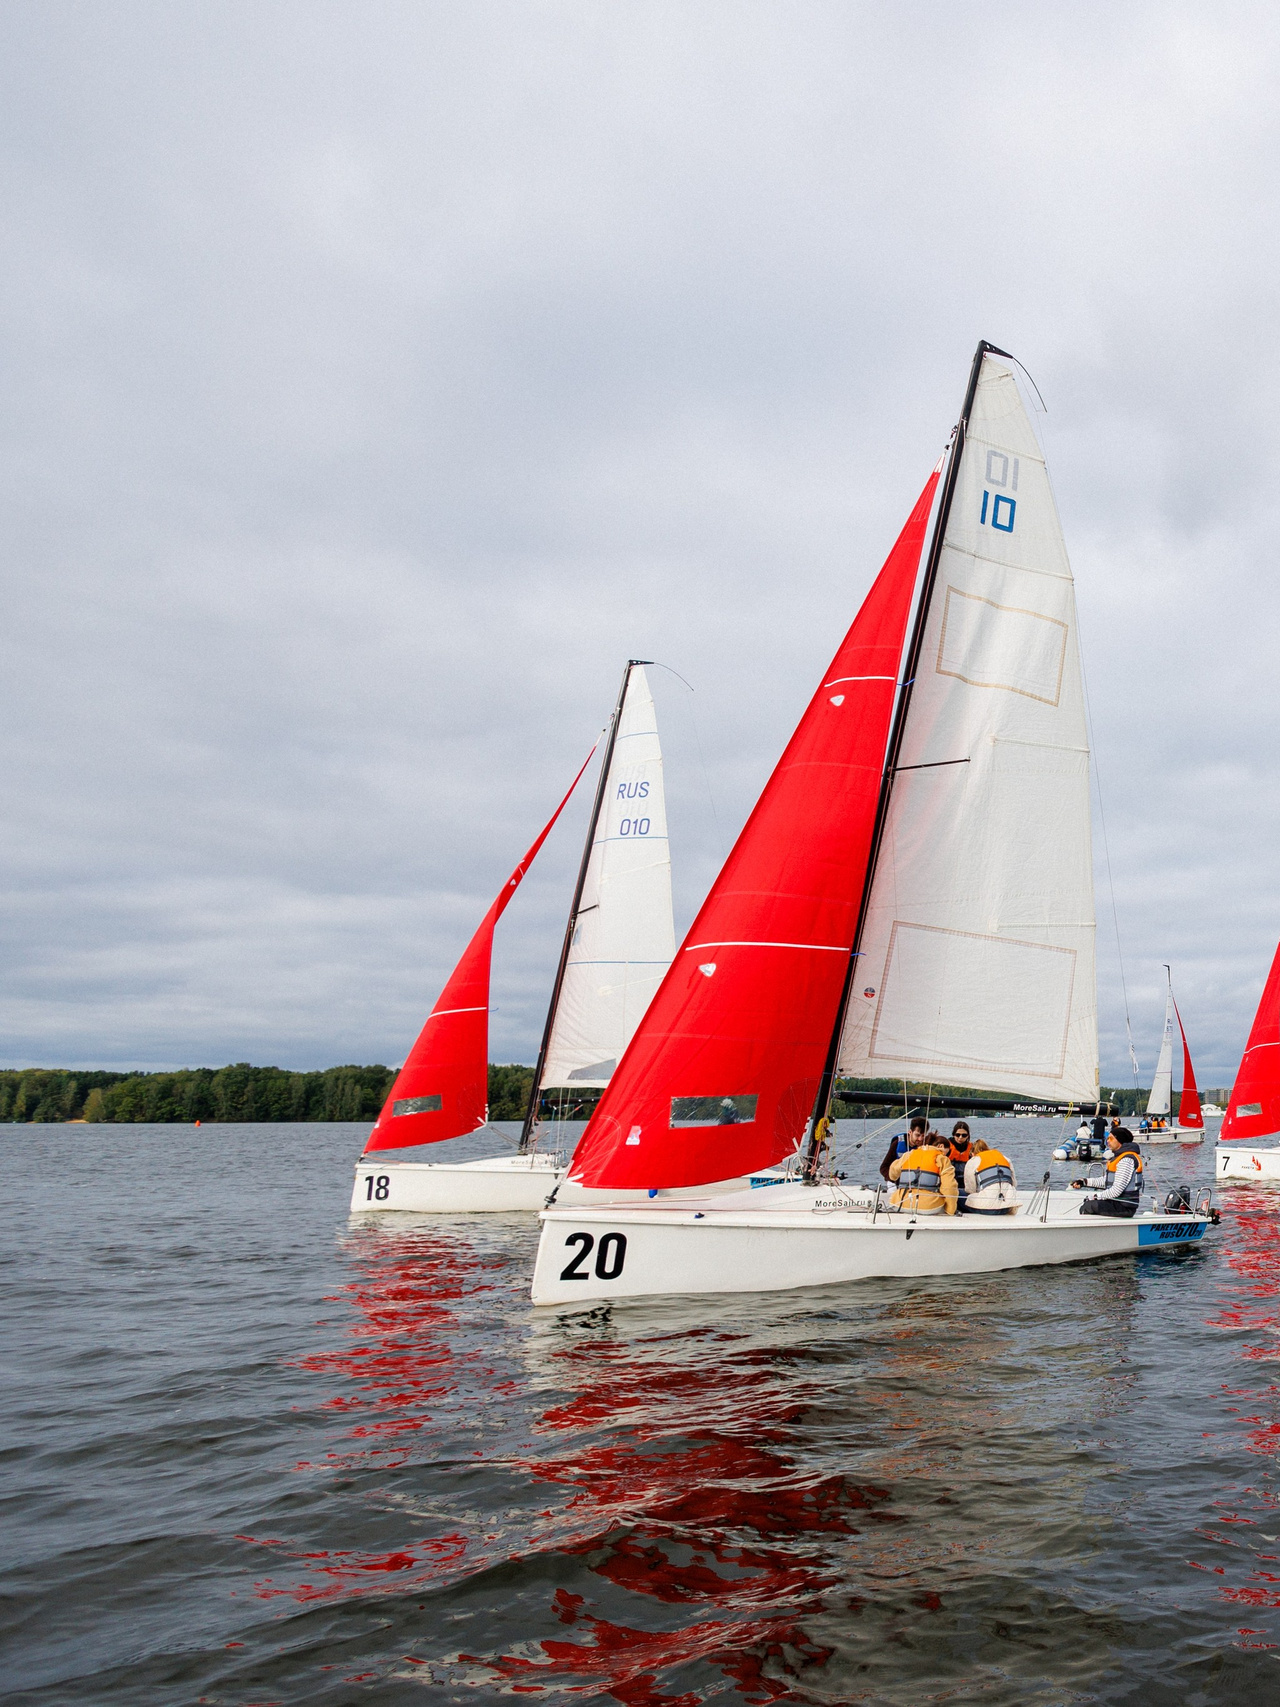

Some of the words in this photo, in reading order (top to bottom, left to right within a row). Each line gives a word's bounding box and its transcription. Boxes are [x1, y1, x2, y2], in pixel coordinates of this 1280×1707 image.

[980, 490, 1017, 533] 10
[616, 781, 650, 800] RUS
[619, 818, 651, 836] 010
[1013, 1104, 1057, 1113] MoreSail.ru
[1222, 1156, 1231, 1171] 7
[365, 1175, 390, 1201] 18
[1159, 1231, 1176, 1239] RUS
[560, 1232, 628, 1281] 20
